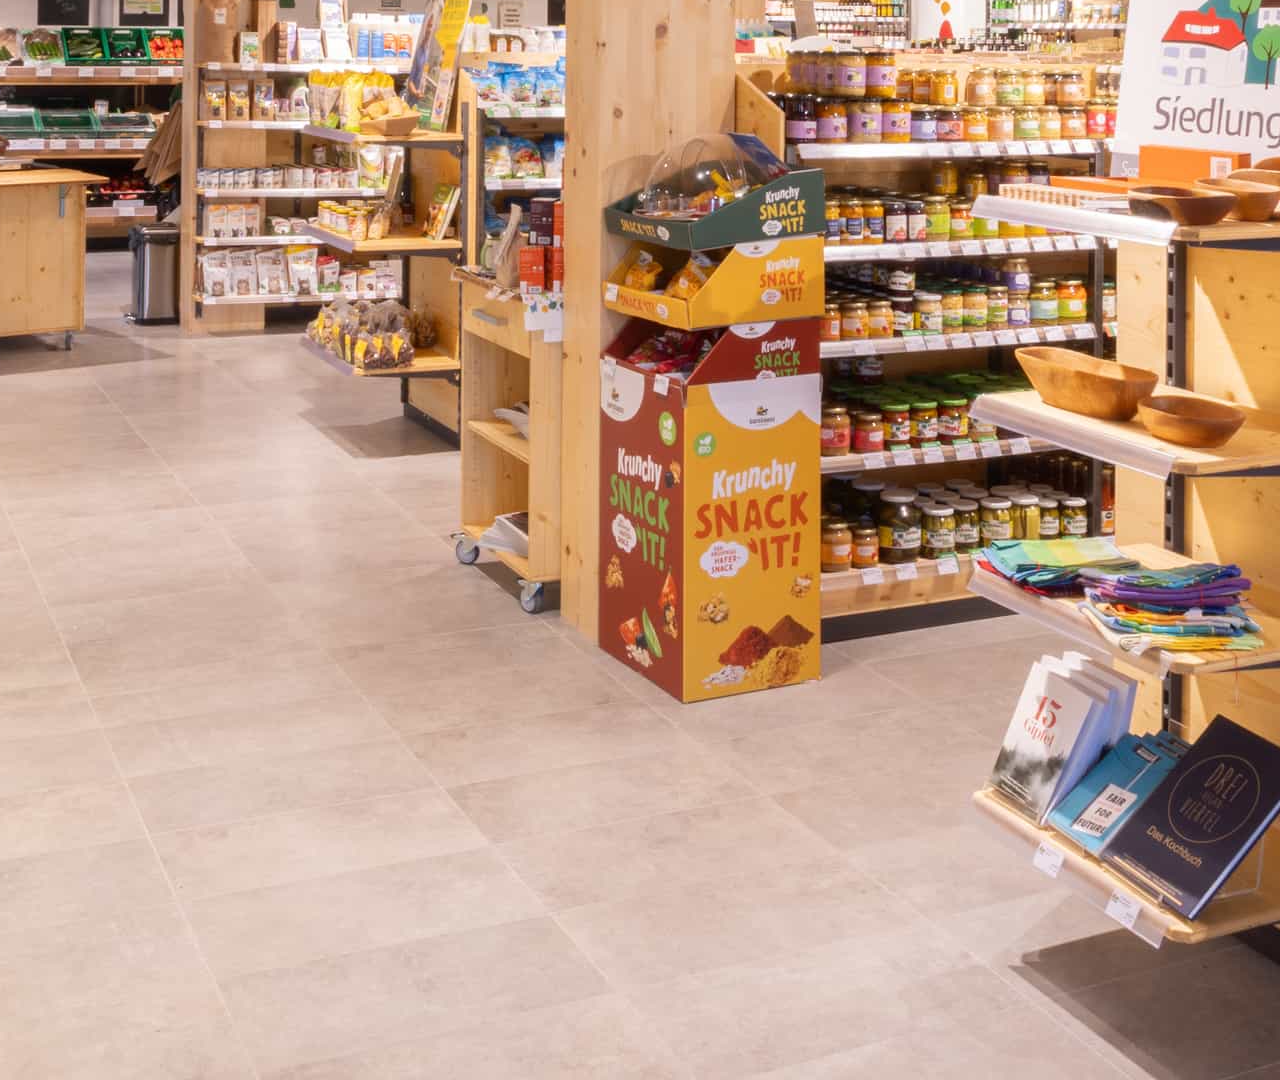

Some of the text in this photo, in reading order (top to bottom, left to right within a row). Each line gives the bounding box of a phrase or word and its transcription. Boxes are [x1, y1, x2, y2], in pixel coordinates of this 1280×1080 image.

[765, 186, 801, 204] Krunchy
[759, 199, 806, 220] SNACK
[759, 270, 805, 289] SNACK
[761, 336, 797, 354] Krunchy
[753, 351, 801, 369] SNACK
[617, 447, 662, 491] Krunchy
[712, 458, 797, 500] Krunchy
[610, 473, 670, 535] SNACK
[694, 491, 809, 539] SNACK
[1034, 695, 1062, 729] 15
[1105, 792, 1126, 807] FAIR
[1095, 806, 1113, 819] FOR
[1076, 817, 1106, 834] FUTURE
[1145, 824, 1203, 868] Das Kochbuch
